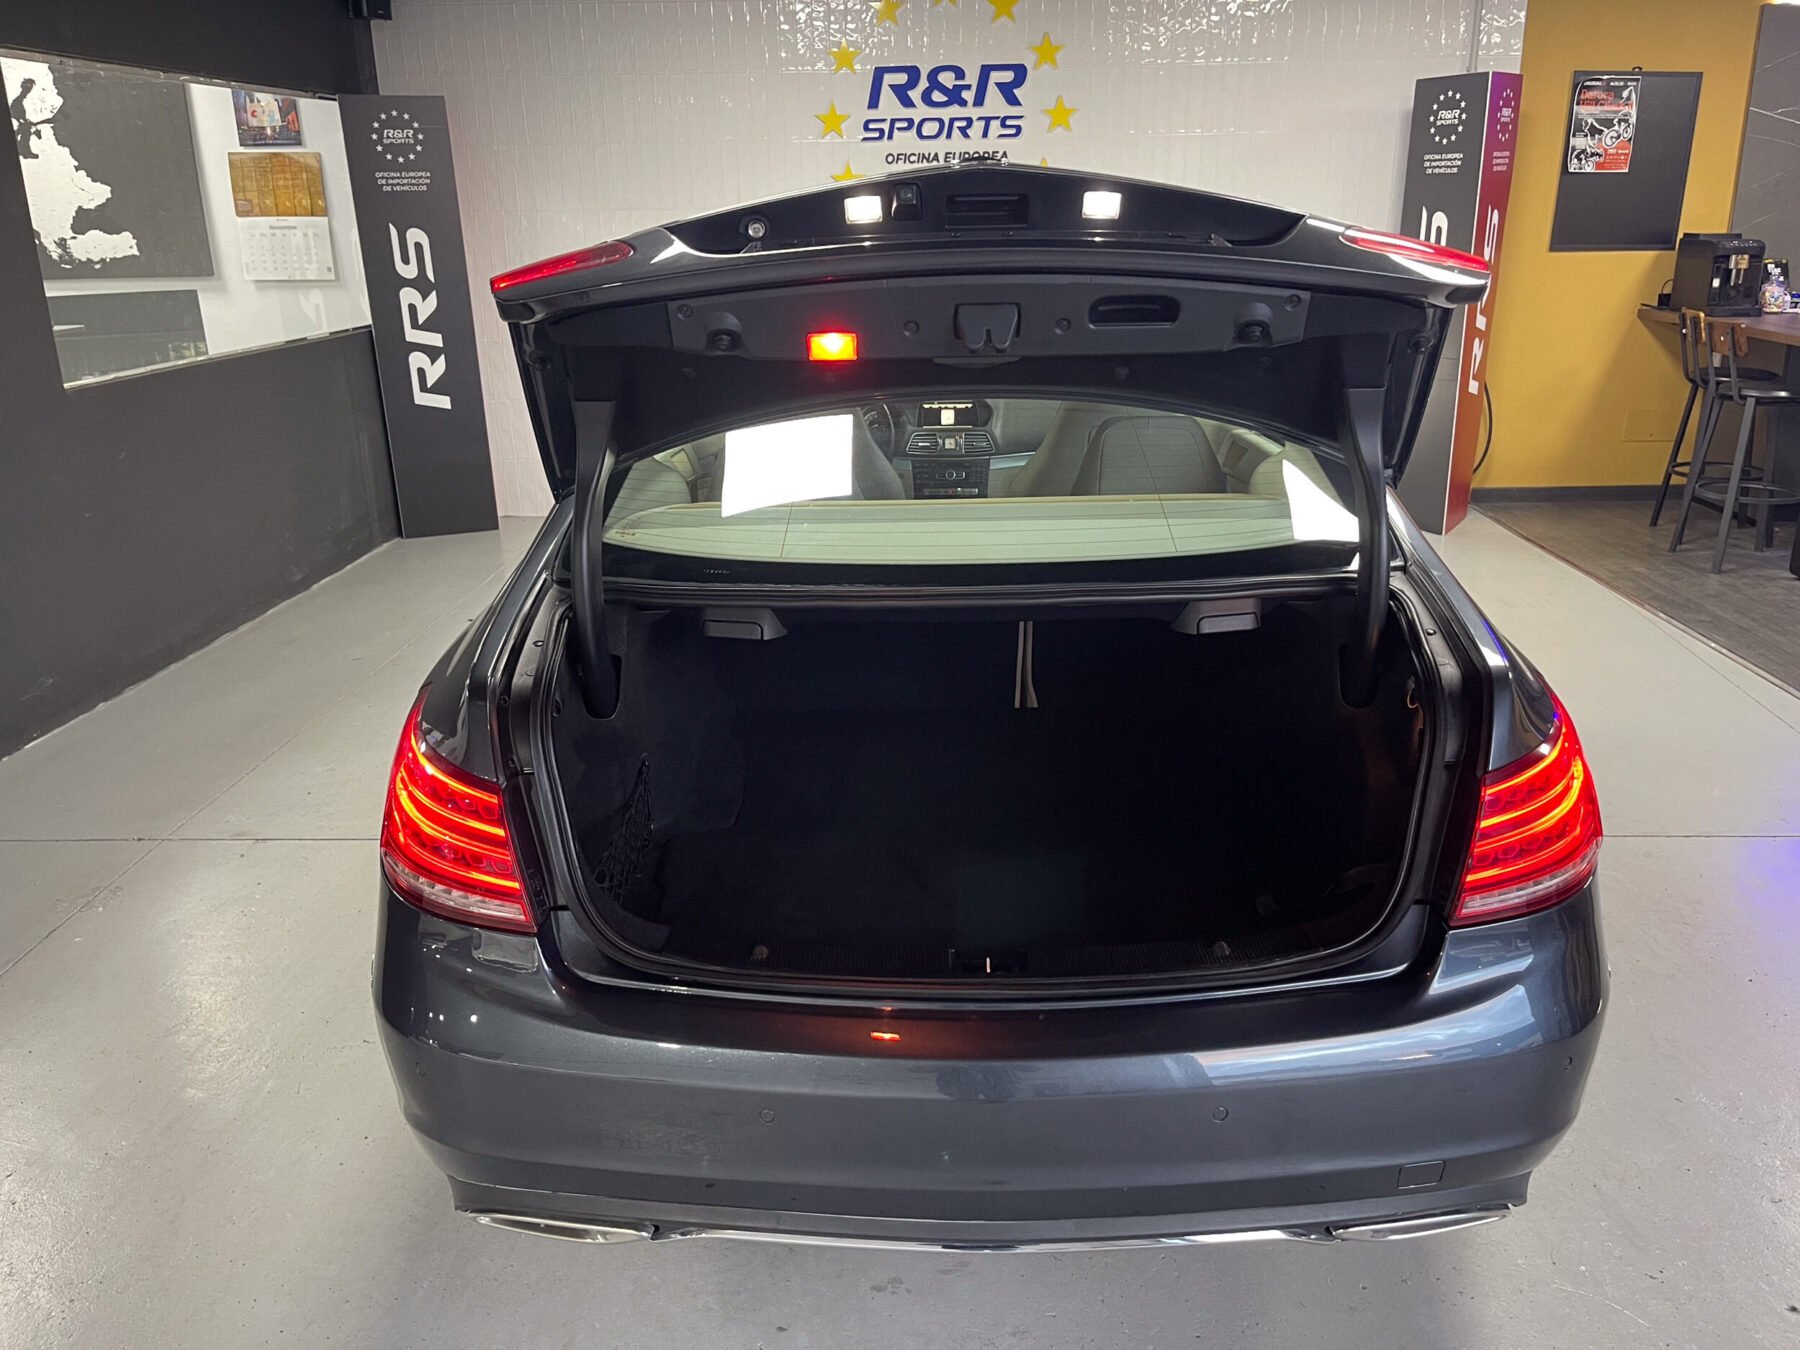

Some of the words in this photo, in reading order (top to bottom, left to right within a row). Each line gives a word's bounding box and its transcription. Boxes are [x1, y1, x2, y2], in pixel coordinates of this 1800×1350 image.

[867, 63, 1028, 109] R&R
[1437, 109, 1461, 120] R&R
[383, 129, 414, 138] R&R
[861, 115, 1025, 141] SPORTS
[885, 152, 941, 165] OFICINA
[388, 222, 452, 410] RRS
